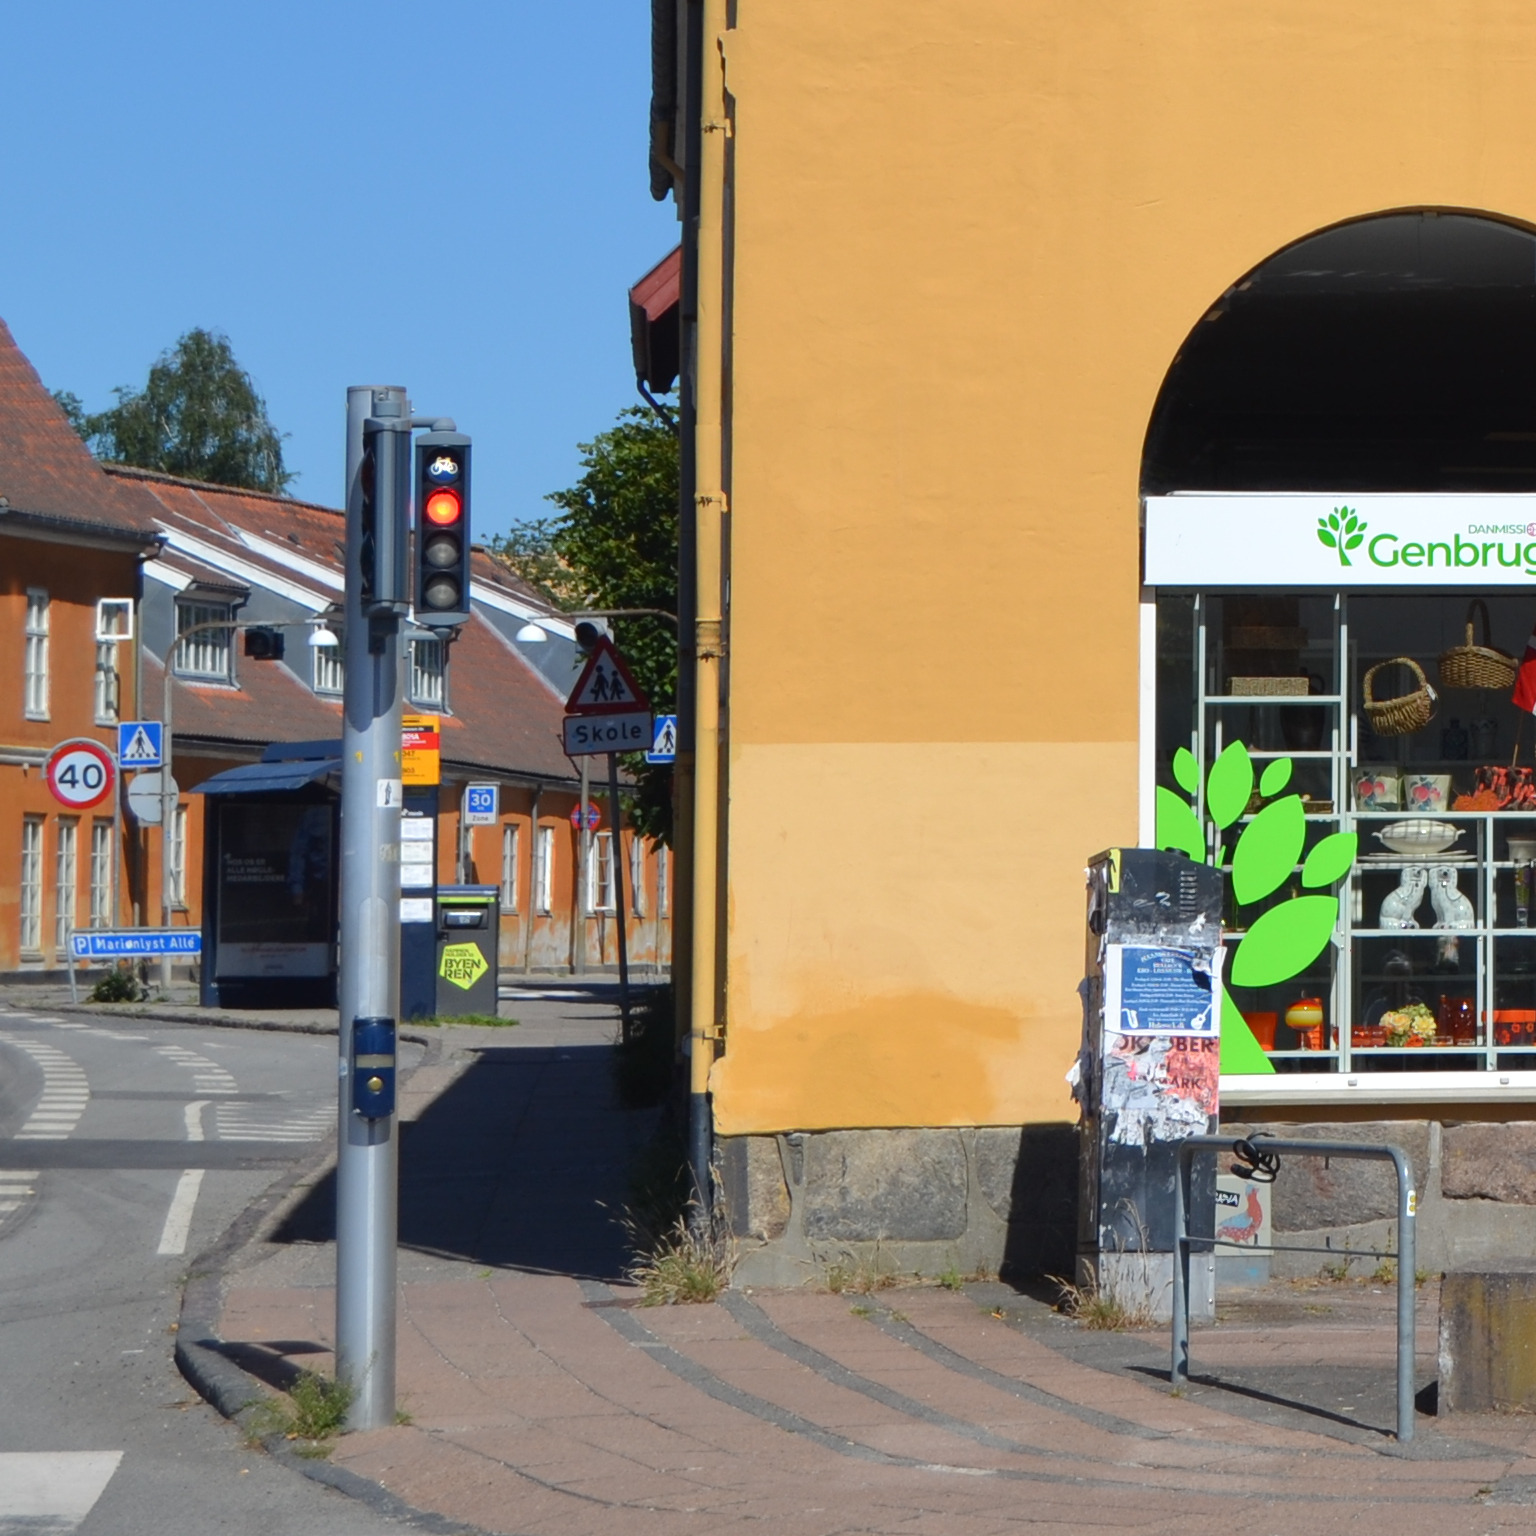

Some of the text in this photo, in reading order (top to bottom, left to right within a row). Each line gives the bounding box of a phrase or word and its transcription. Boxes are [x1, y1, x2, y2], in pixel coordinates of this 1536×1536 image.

[575, 722, 642, 744] Skole
[58, 764, 103, 789] 40
[471, 793, 491, 806] 30
[76, 936, 87, 953] P
[445, 958, 480, 969] BYEN
[445, 969, 473, 979] REN
[1118, 1035, 1214, 1053] OKBER
